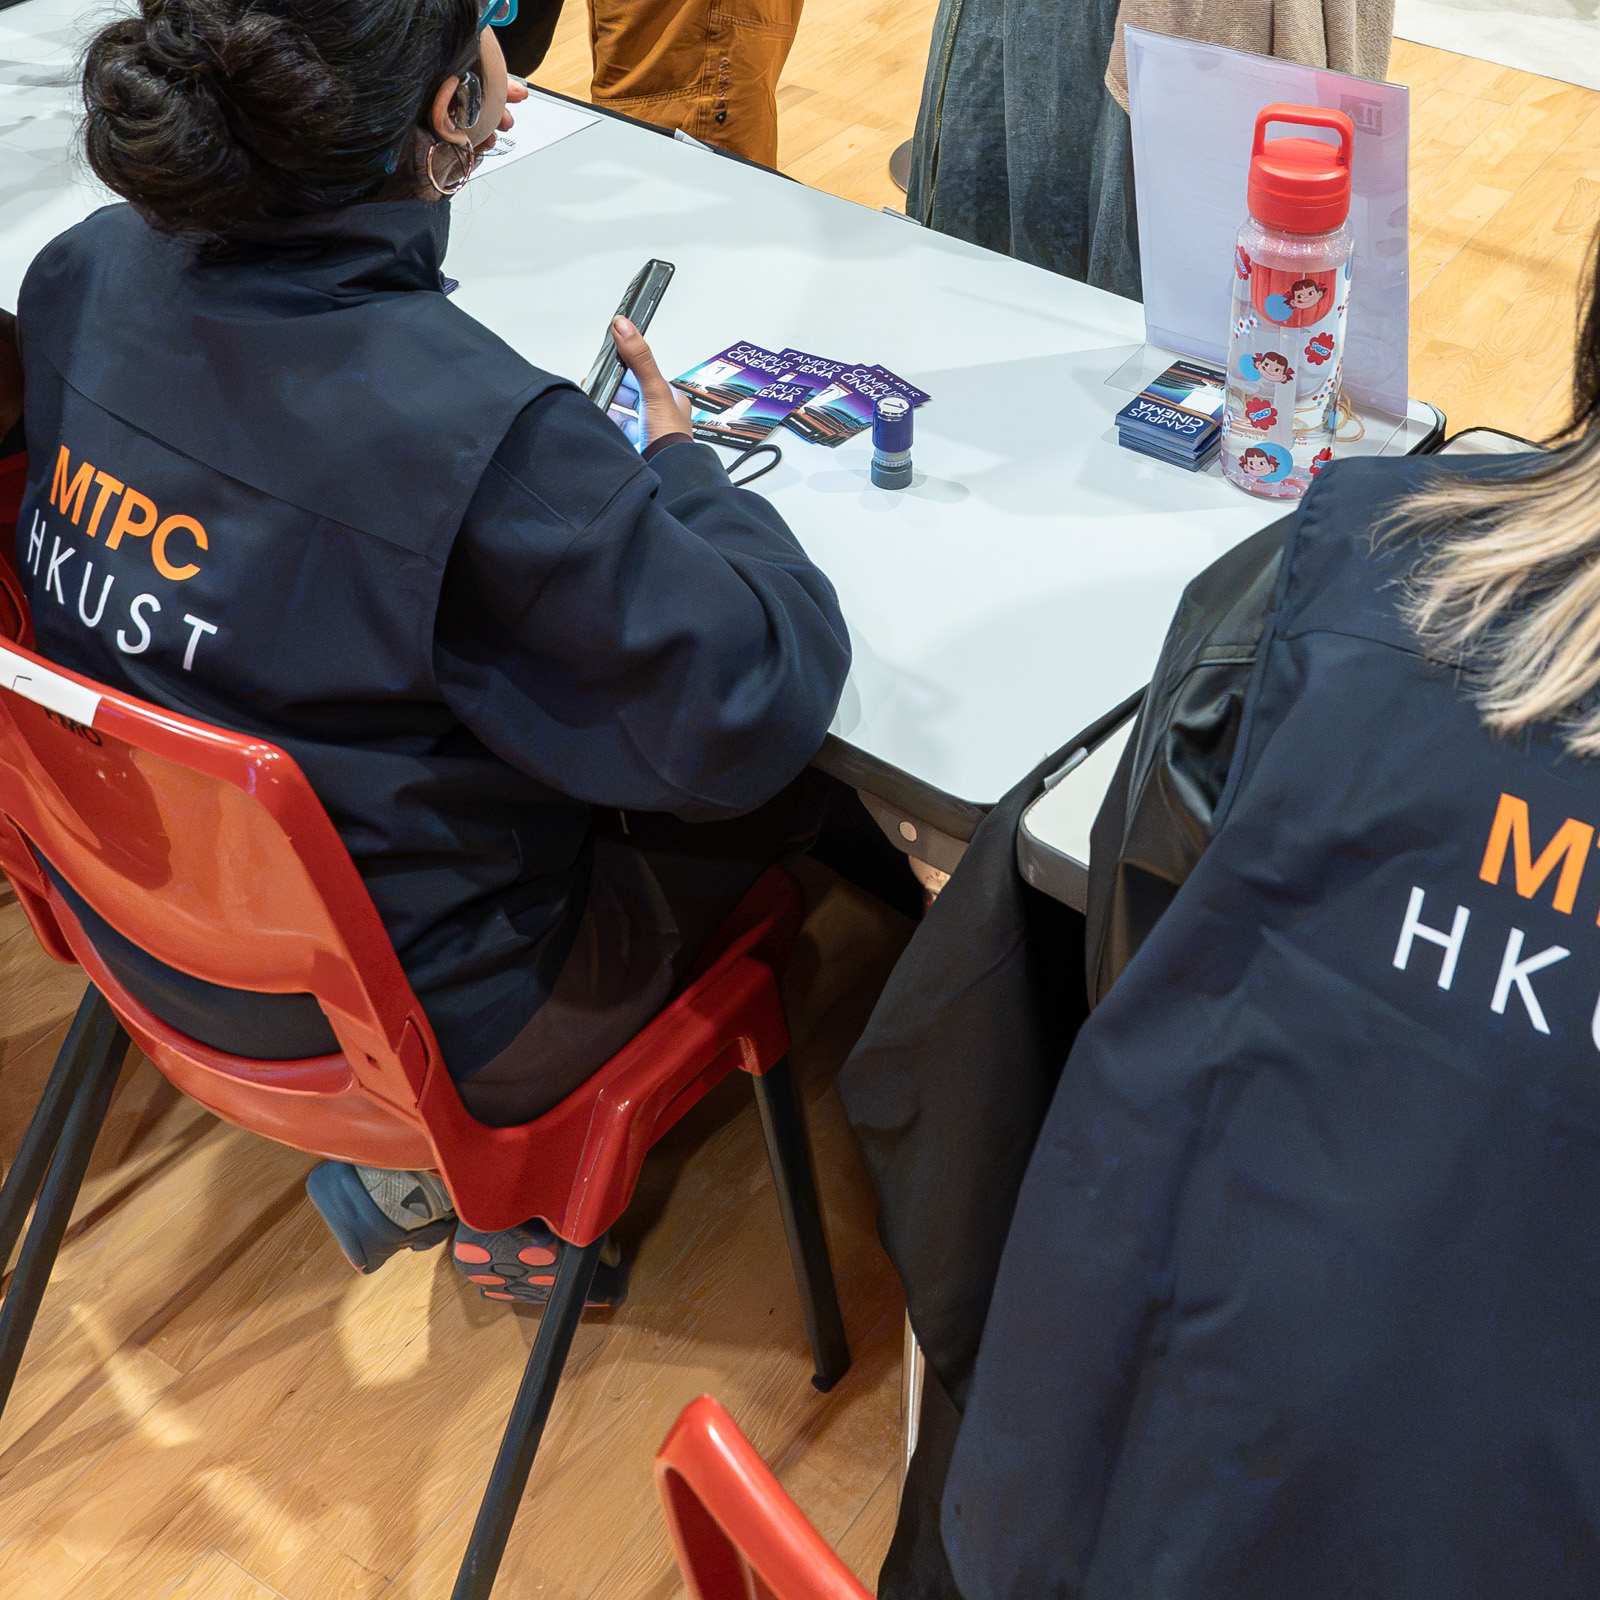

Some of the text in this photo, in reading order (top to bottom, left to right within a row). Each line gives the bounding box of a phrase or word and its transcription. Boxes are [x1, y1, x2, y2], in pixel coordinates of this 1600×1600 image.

[727, 351, 781, 375] CINEMA
[736, 345, 794, 369] CAMPUS
[1128, 408, 1197, 434] CAMPUS
[1140, 401, 1204, 427] CINEMA
[50, 445, 209, 581] MTPC
[27, 509, 218, 671] HKUST
